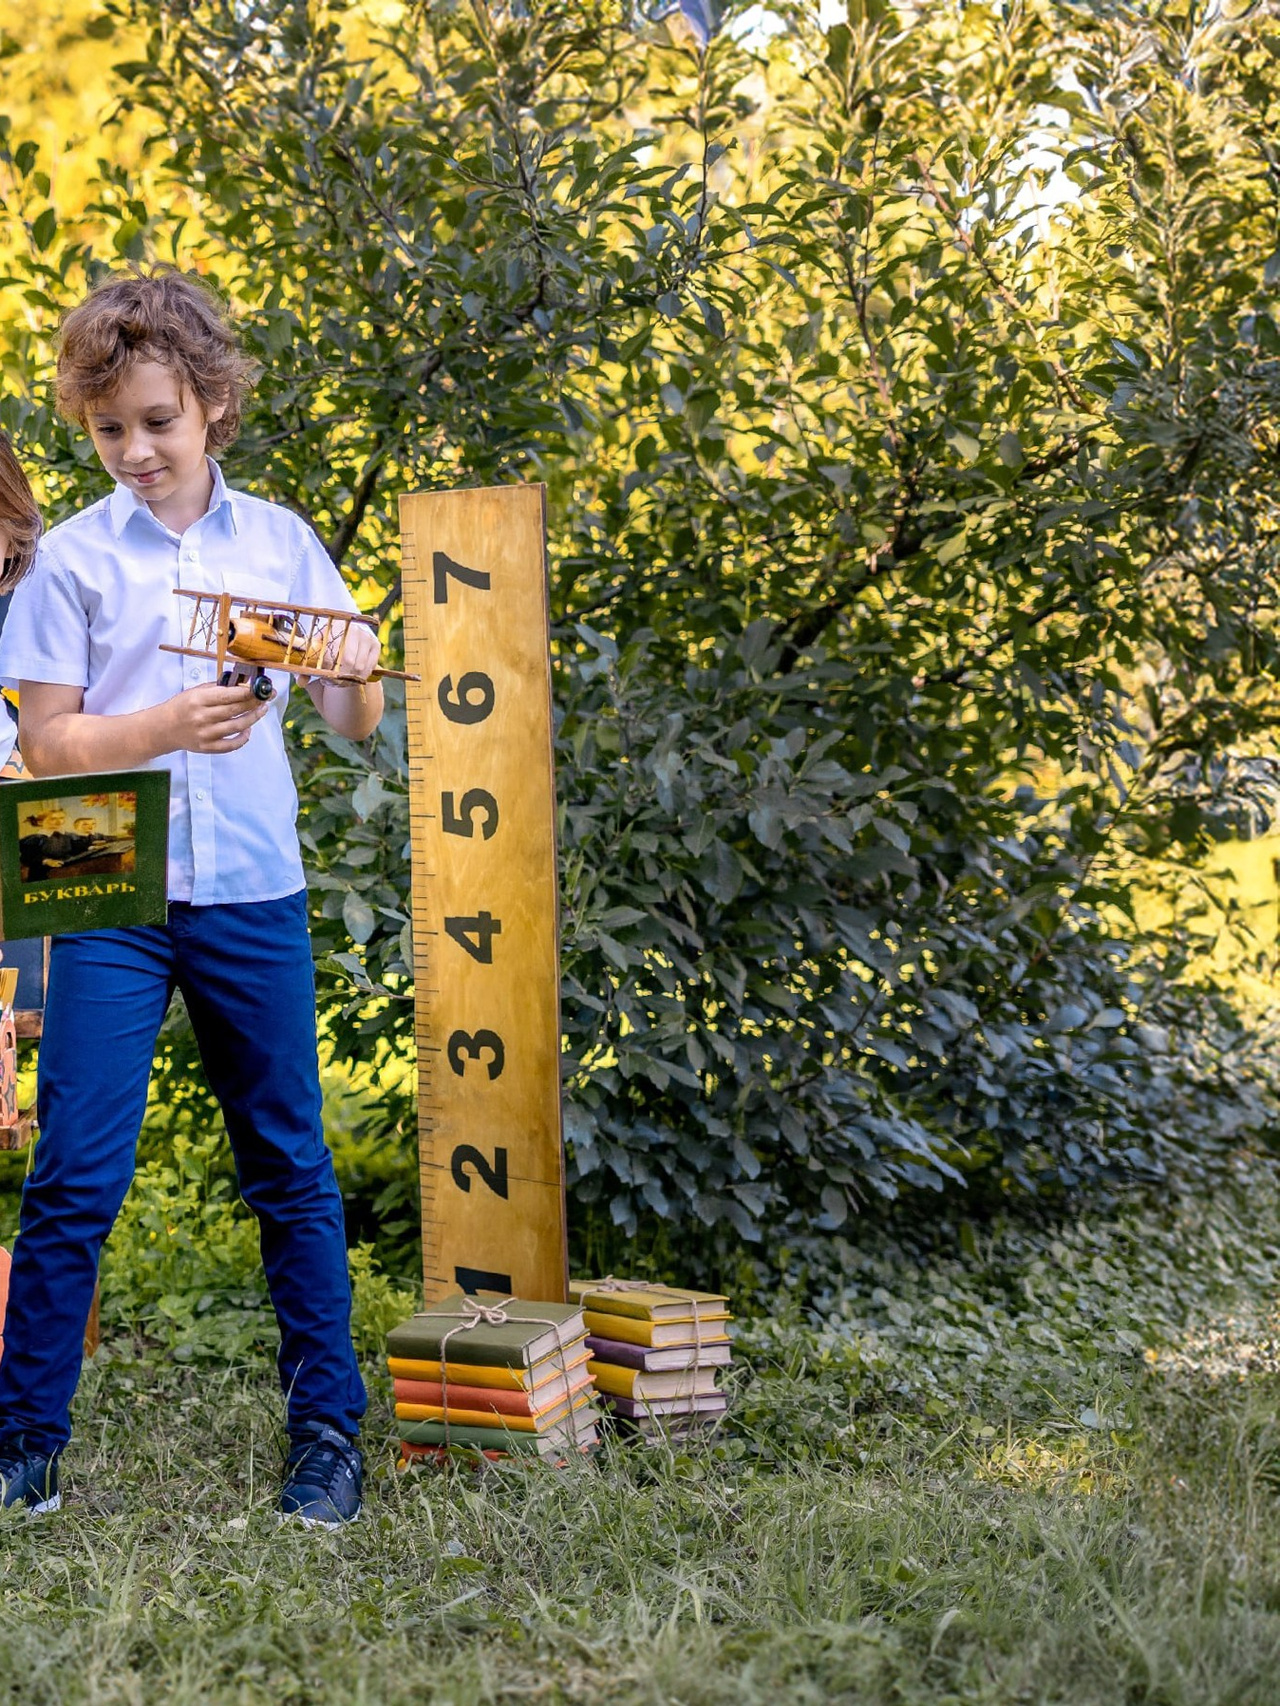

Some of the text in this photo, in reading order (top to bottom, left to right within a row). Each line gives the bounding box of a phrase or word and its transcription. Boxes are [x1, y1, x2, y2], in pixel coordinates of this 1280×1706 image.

[433, 551, 491, 604] 7
[437, 671, 496, 725] 6
[441, 787, 500, 841] 5
[23, 882, 136, 905] БУКВАРЬ
[444, 910, 502, 965] 4
[447, 1029, 506, 1081] 3
[451, 1144, 509, 1200] 2
[454, 1266, 512, 1296] 1
